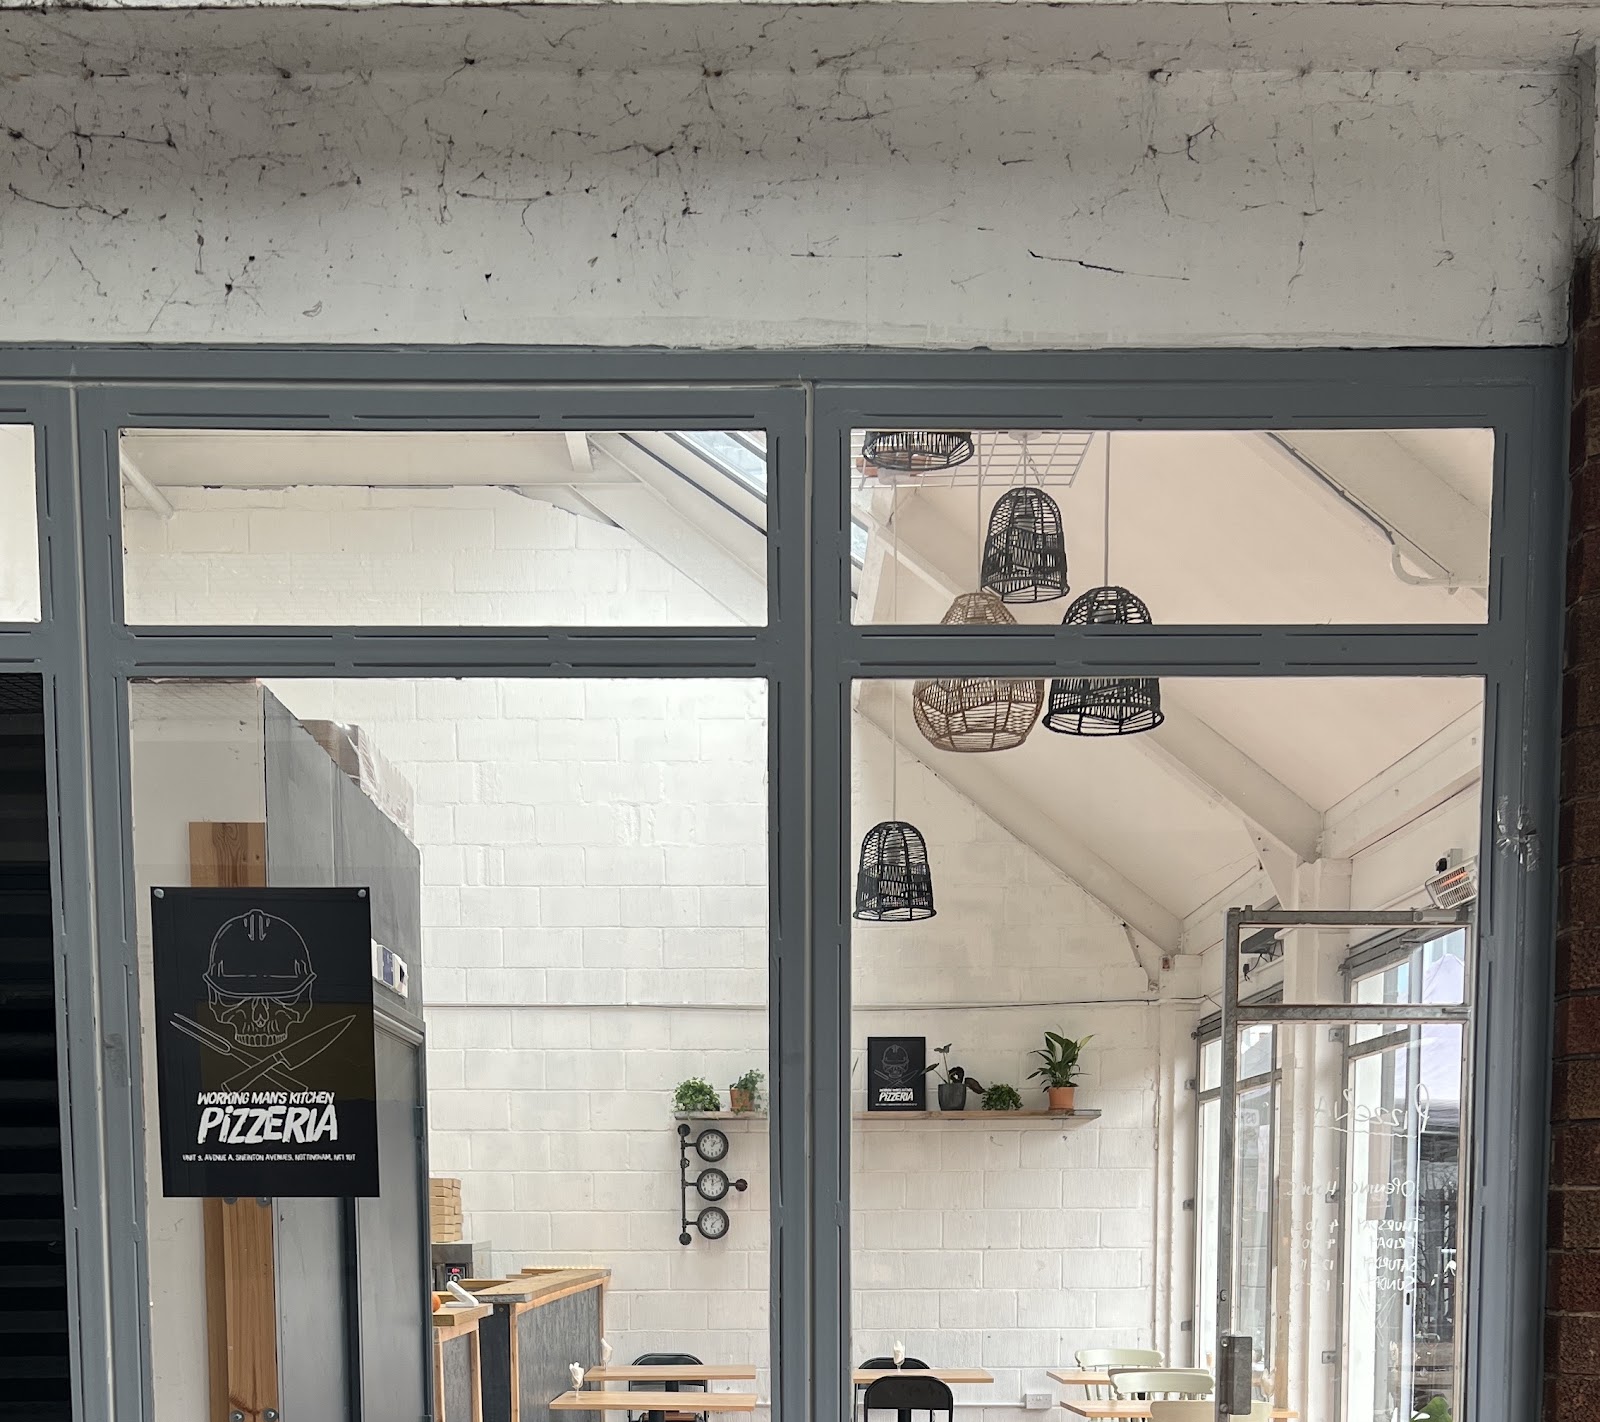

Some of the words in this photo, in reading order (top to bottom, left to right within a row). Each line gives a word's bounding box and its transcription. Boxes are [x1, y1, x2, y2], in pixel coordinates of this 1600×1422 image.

[251, 1091, 288, 1105] MAN'S
[289, 1091, 335, 1105] KITCHEN
[182, 1154, 197, 1162] UNIT
[204, 1154, 227, 1162] AVENUE
